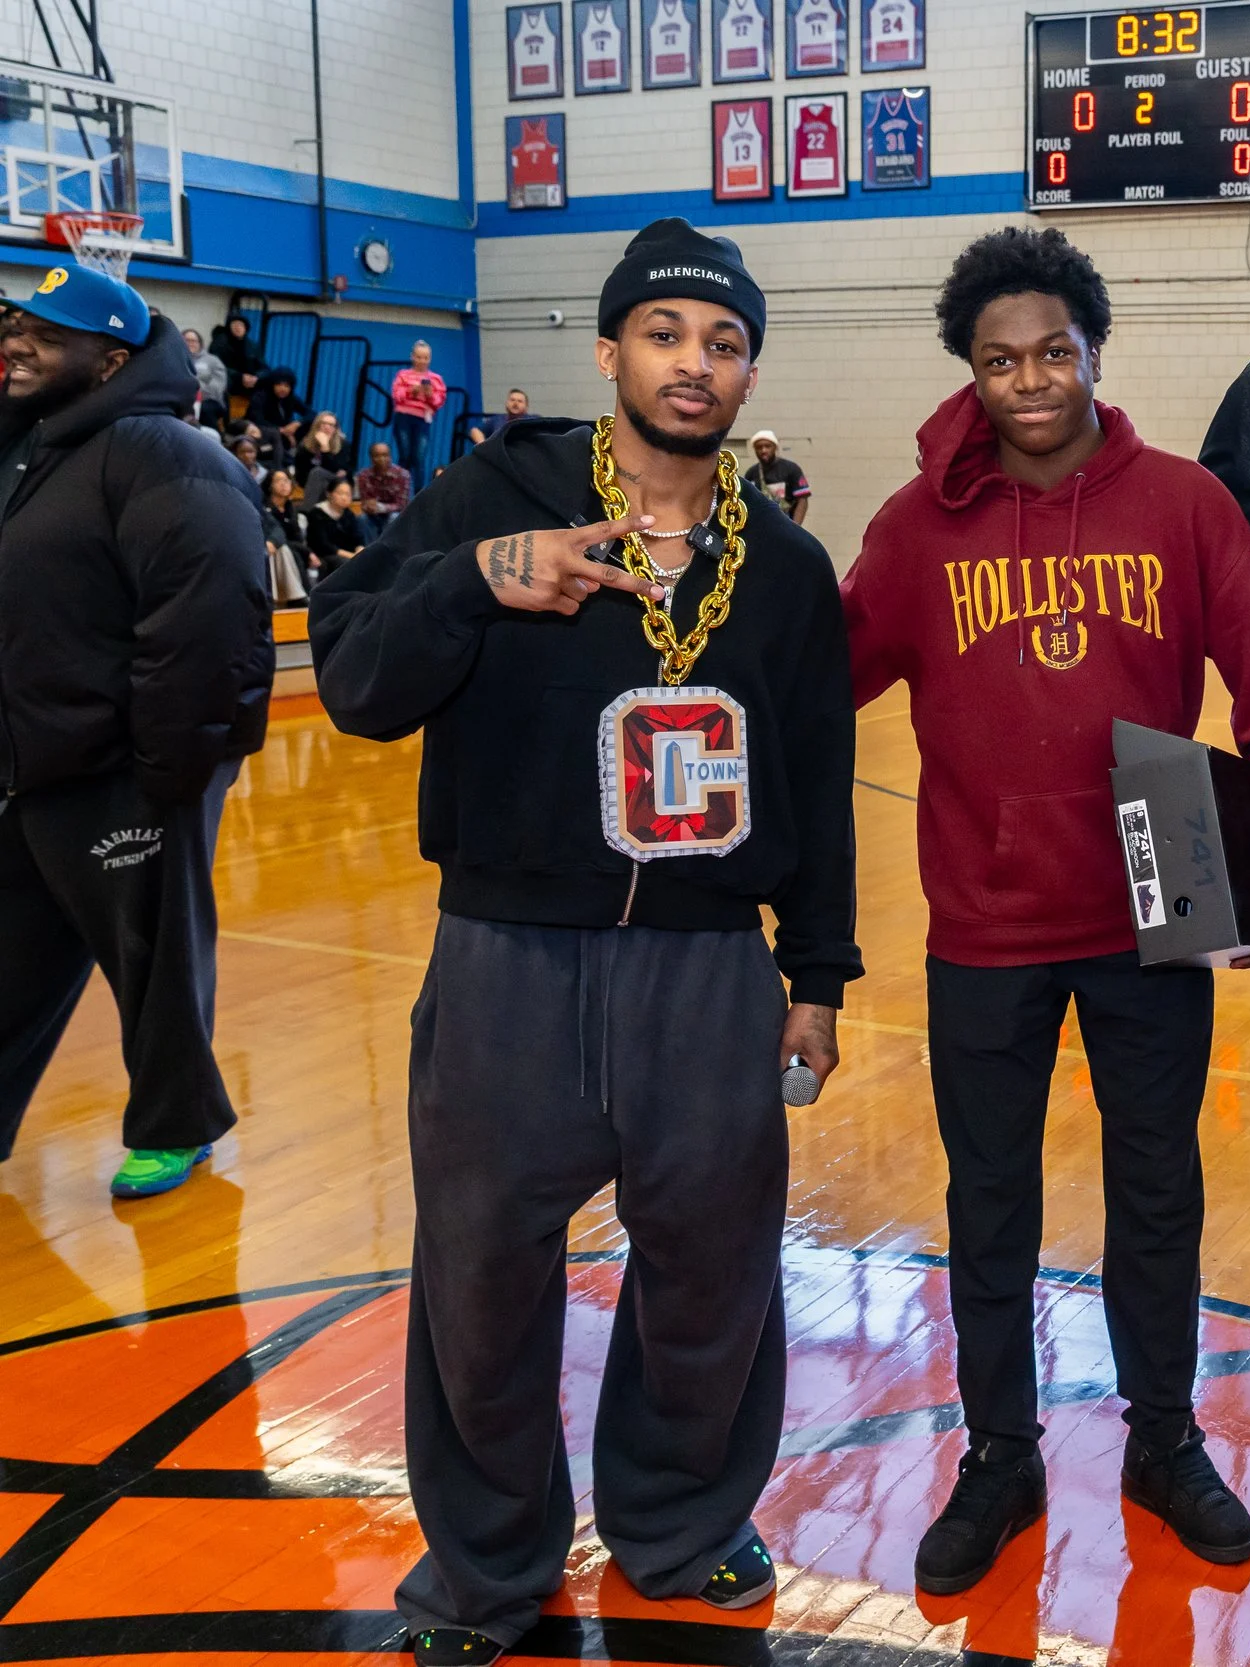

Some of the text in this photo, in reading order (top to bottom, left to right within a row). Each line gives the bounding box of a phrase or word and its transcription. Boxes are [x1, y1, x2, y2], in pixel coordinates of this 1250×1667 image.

[882, 16, 904, 34] 24
[1117, 11, 1198, 55] 8:32
[1043, 68, 1090, 88] HOME
[1125, 74, 1165, 89] PERIOD
[1074, 92, 1094, 131] 0
[1136, 92, 1153, 124] 2
[807, 133, 825, 150] 22
[885, 132, 905, 151] 31
[1036, 138, 1071, 152] FOULS
[1108, 131, 1183, 148] PLAYER FOUL
[734, 145, 751, 162] 13
[1049, 153, 1066, 182] 0
[1036, 190, 1071, 203] SCORE
[1125, 186, 1164, 200] MATCH
[650, 267, 731, 286] BALENCIAGA
[944, 553, 1164, 656] HOLLISTER
[684, 762, 738, 781] TOWN
[1139, 828, 1151, 860] 741
